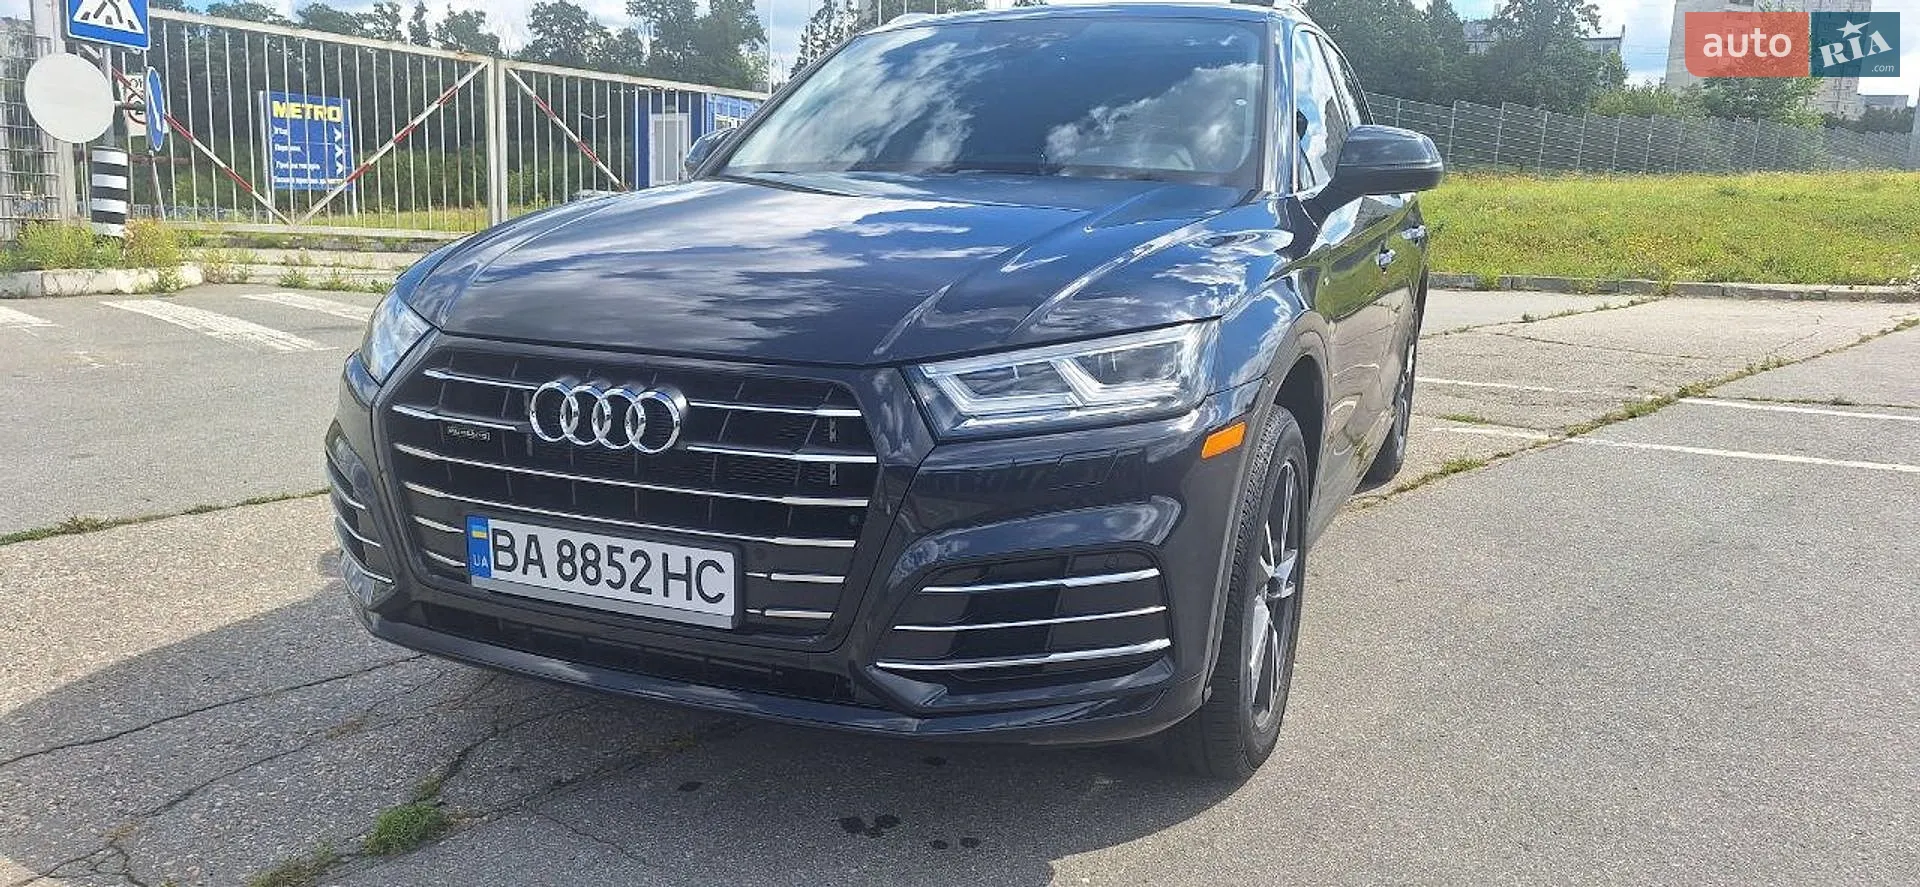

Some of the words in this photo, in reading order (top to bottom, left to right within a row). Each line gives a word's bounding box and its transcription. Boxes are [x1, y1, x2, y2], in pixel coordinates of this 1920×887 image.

[272, 100, 343, 123] METRO
[473, 553, 489, 569] UA
[491, 528, 547, 579] BA
[556, 538, 652, 595] 8852
[661, 552, 726, 604] HC
